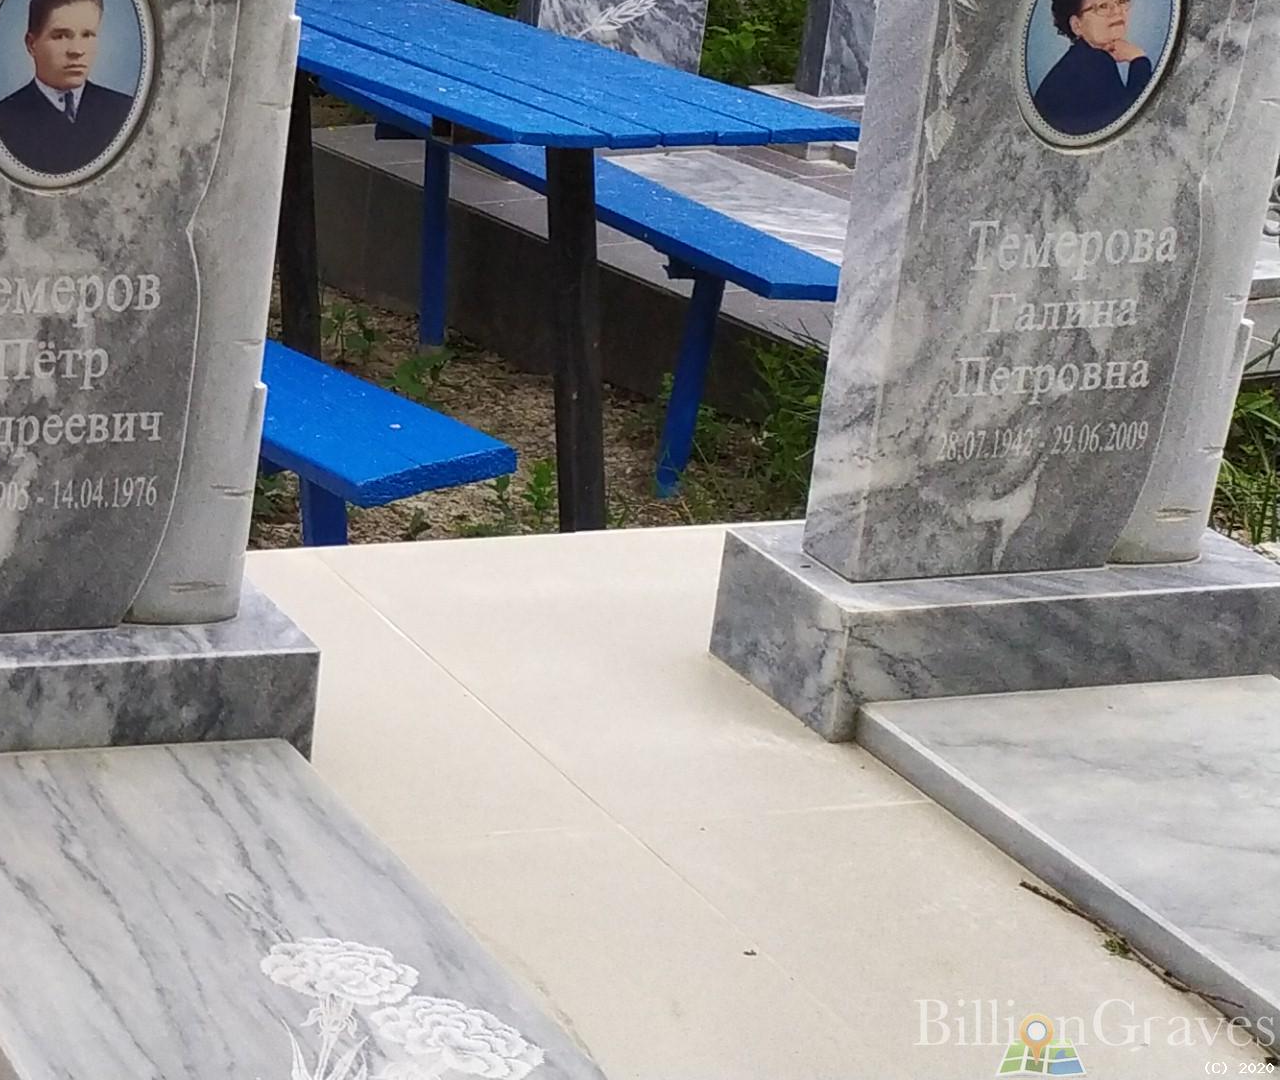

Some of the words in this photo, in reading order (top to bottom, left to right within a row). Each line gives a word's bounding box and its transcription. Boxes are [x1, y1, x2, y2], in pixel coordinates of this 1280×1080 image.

[968, 219, 1178, 281] Темерова
[984, 293, 1140, 334] Галина
[951, 356, 1151, 406] Петровна
[1051, 420, 1150, 457] 29.06.2009
[52, 475, 158, 511] 14.04.1976
